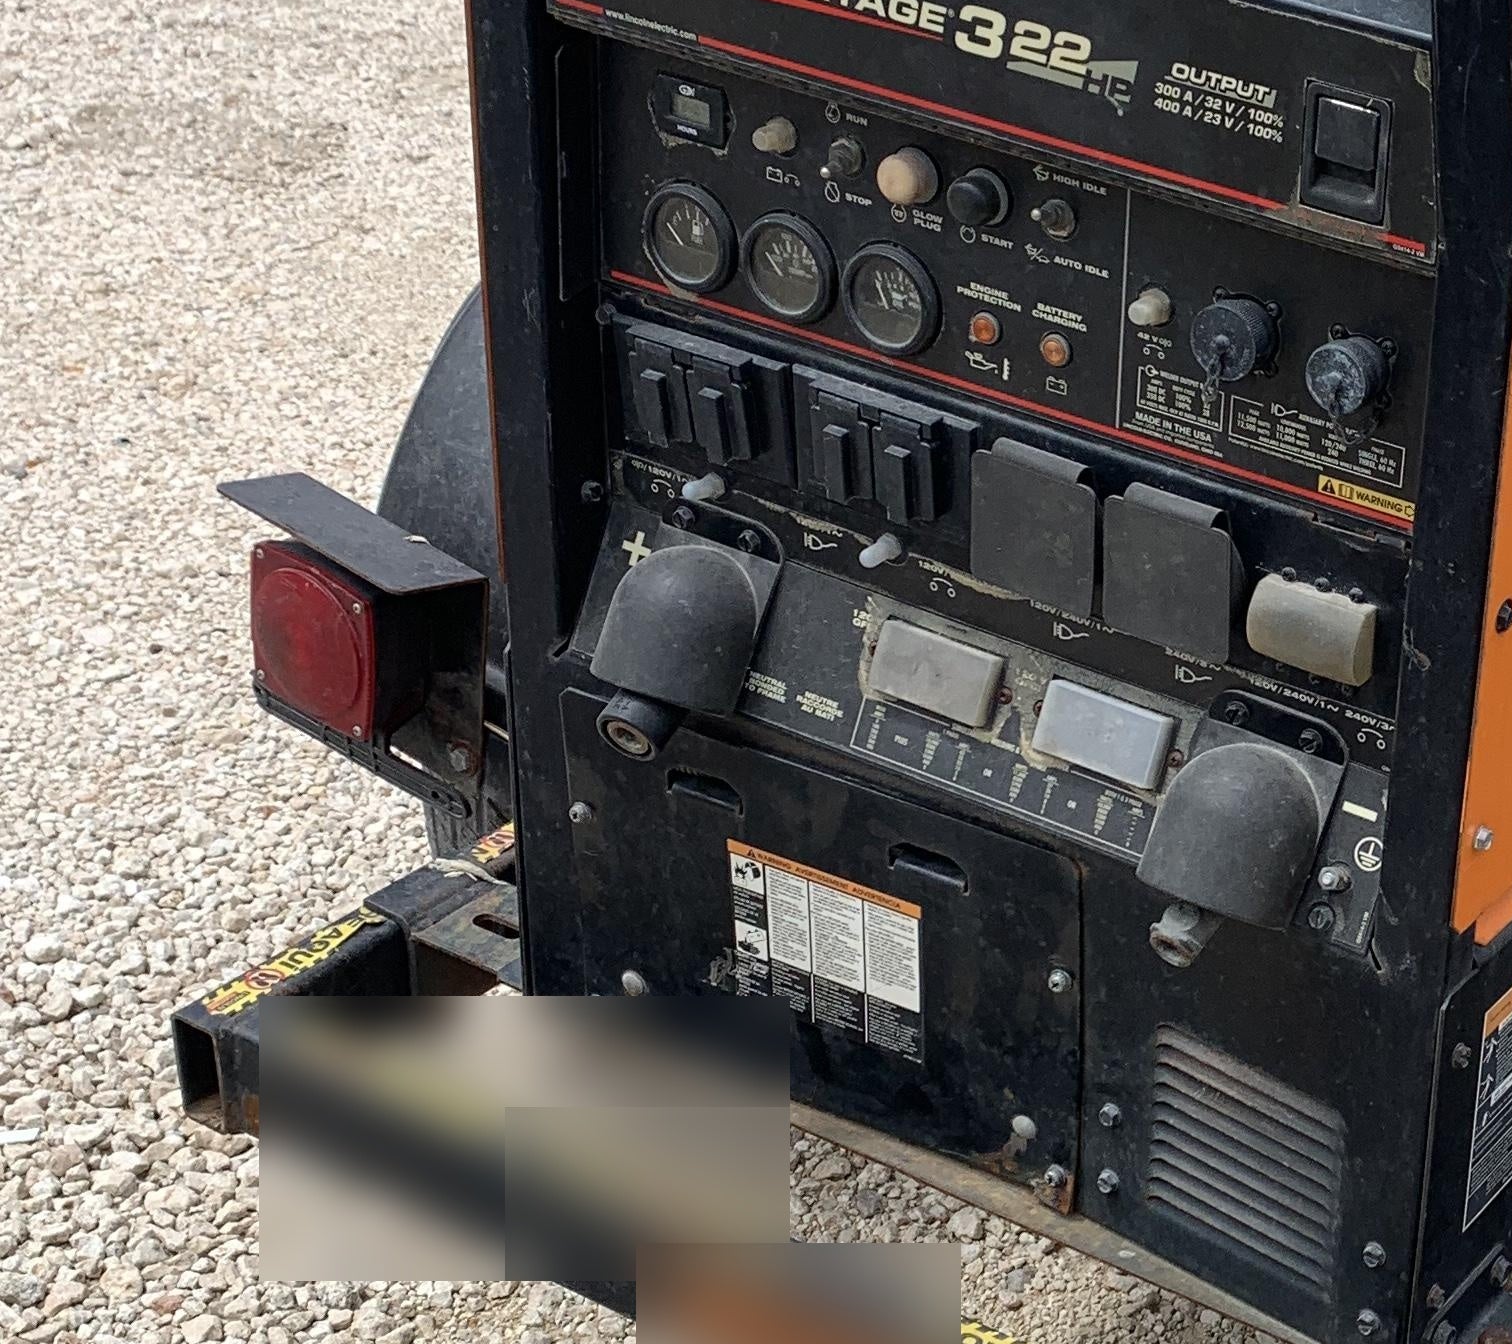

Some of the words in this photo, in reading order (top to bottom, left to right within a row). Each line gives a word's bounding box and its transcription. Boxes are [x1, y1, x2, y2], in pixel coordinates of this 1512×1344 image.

[605, 8, 697, 41] www.lincolnelectric.com
[955, 4, 1092, 74] 322
[1171, 62, 1272, 103] OUTPUT
[1154, 82, 1181, 99] 300
[1182, 89, 1195, 103] A
[1204, 95, 1223, 112] 32
[1225, 101, 1236, 114] V
[1248, 107, 1284, 129] 100%
[677, 124, 698, 136] HOURS
[846, 112, 869, 127] RUN
[1153, 96, 1181, 115] 400
[1182, 105, 1195, 119] A
[1203, 111, 1222, 126] 23
[1224, 118, 1236, 131] V
[1247, 123, 1284, 143] 100%
[1052, 173, 1080, 189] HIGH
[1083, 181, 1108, 197] IDLE
[845, 192, 872, 206] STOP
[912, 209, 944, 224] GLOW
[913, 218, 942, 233] PLUG
[981, 233, 1014, 250] START
[1053, 255, 1083, 271] AUTO
[1084, 263, 1110, 279] IDLE
[956, 285, 1022, 313] PROTECTION
[969, 281, 1009, 300] ENGINE
[1031, 308, 1088, 333] CHARGING
[1036, 302, 1083, 322] BATTERY
[1135, 411, 1161, 427] MADE
[1162, 419, 1173, 431] IN
[1173, 422, 1192, 437] THE
[1193, 428, 1213, 443] USA
[1356, 490, 1403, 513] WARNING
[750, 670, 787, 690] NEUTRAL
[804, 690, 839, 709] NEUTRE
